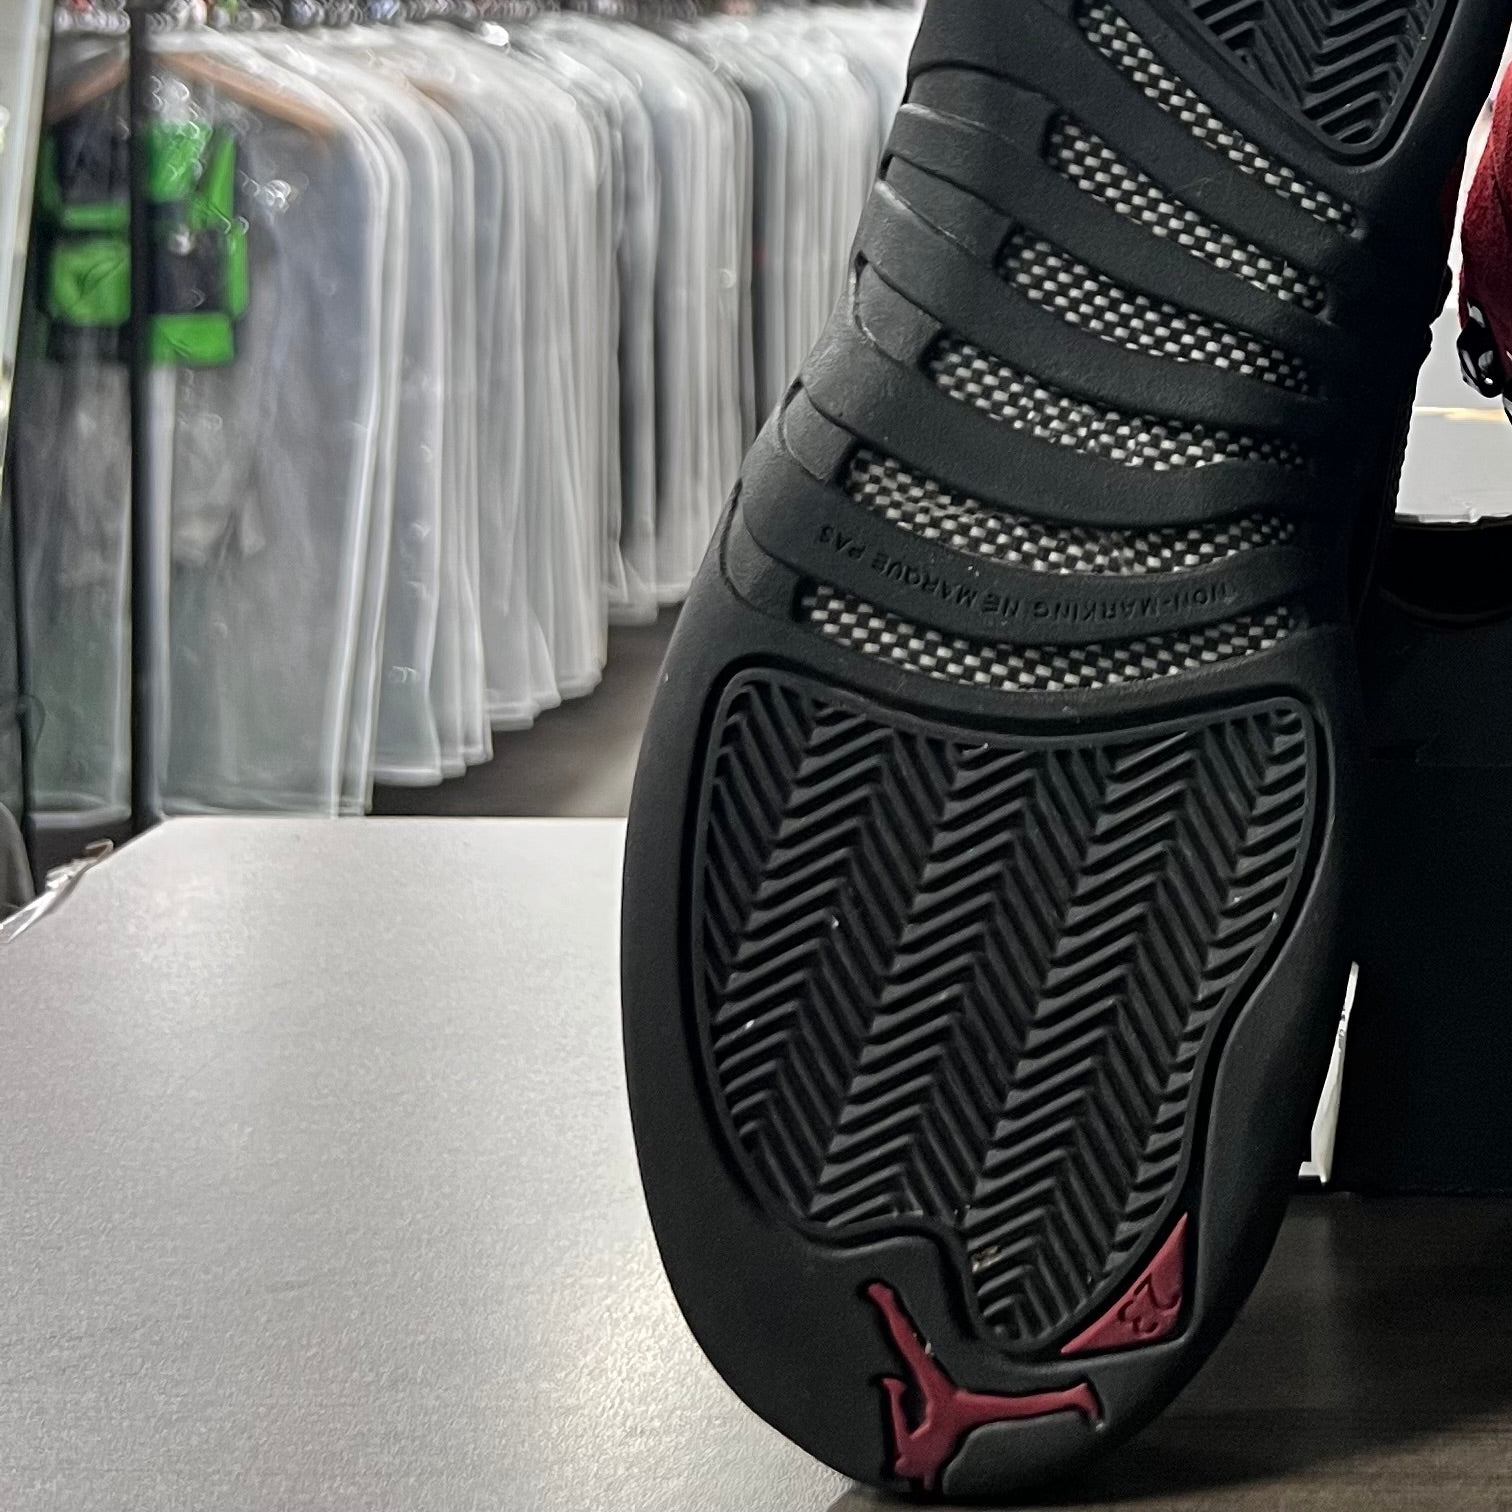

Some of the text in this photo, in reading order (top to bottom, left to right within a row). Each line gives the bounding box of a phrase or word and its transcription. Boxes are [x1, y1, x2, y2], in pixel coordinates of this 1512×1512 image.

[818, 524, 871, 562] PAS
[872, 552, 978, 610] MARQUE
[982, 594, 1023, 616] NE
